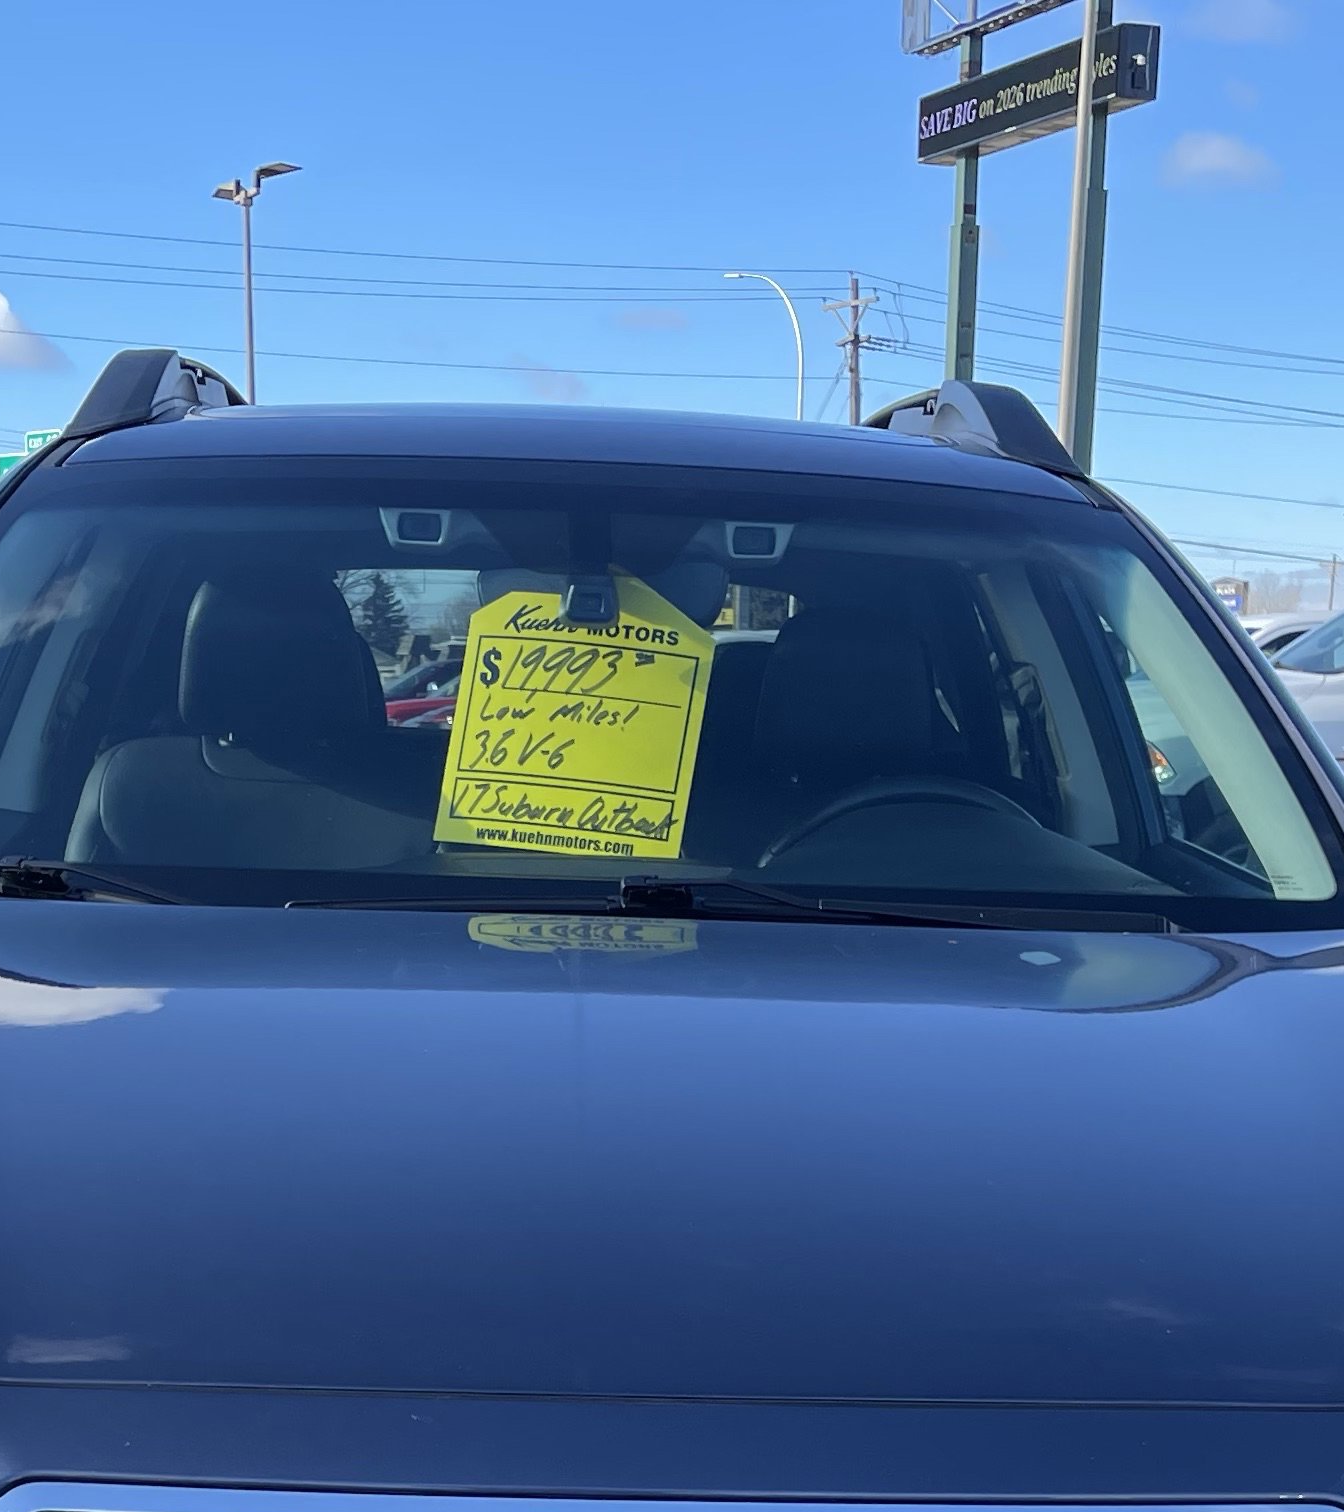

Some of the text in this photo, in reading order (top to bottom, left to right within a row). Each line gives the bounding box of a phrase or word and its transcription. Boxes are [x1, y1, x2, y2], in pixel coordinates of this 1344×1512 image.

[920, 106, 954, 139] SAVE
[953, 98, 978, 129] BIG
[978, 99, 995, 119] on
[995, 82, 1025, 113] 2026
[1026, 66, 1079, 103] trending
[479, 693, 640, 732] Low Miles!
[517, 732, 576, 770] V-6
[475, 827, 634, 857] www.kuehnmotors.com
